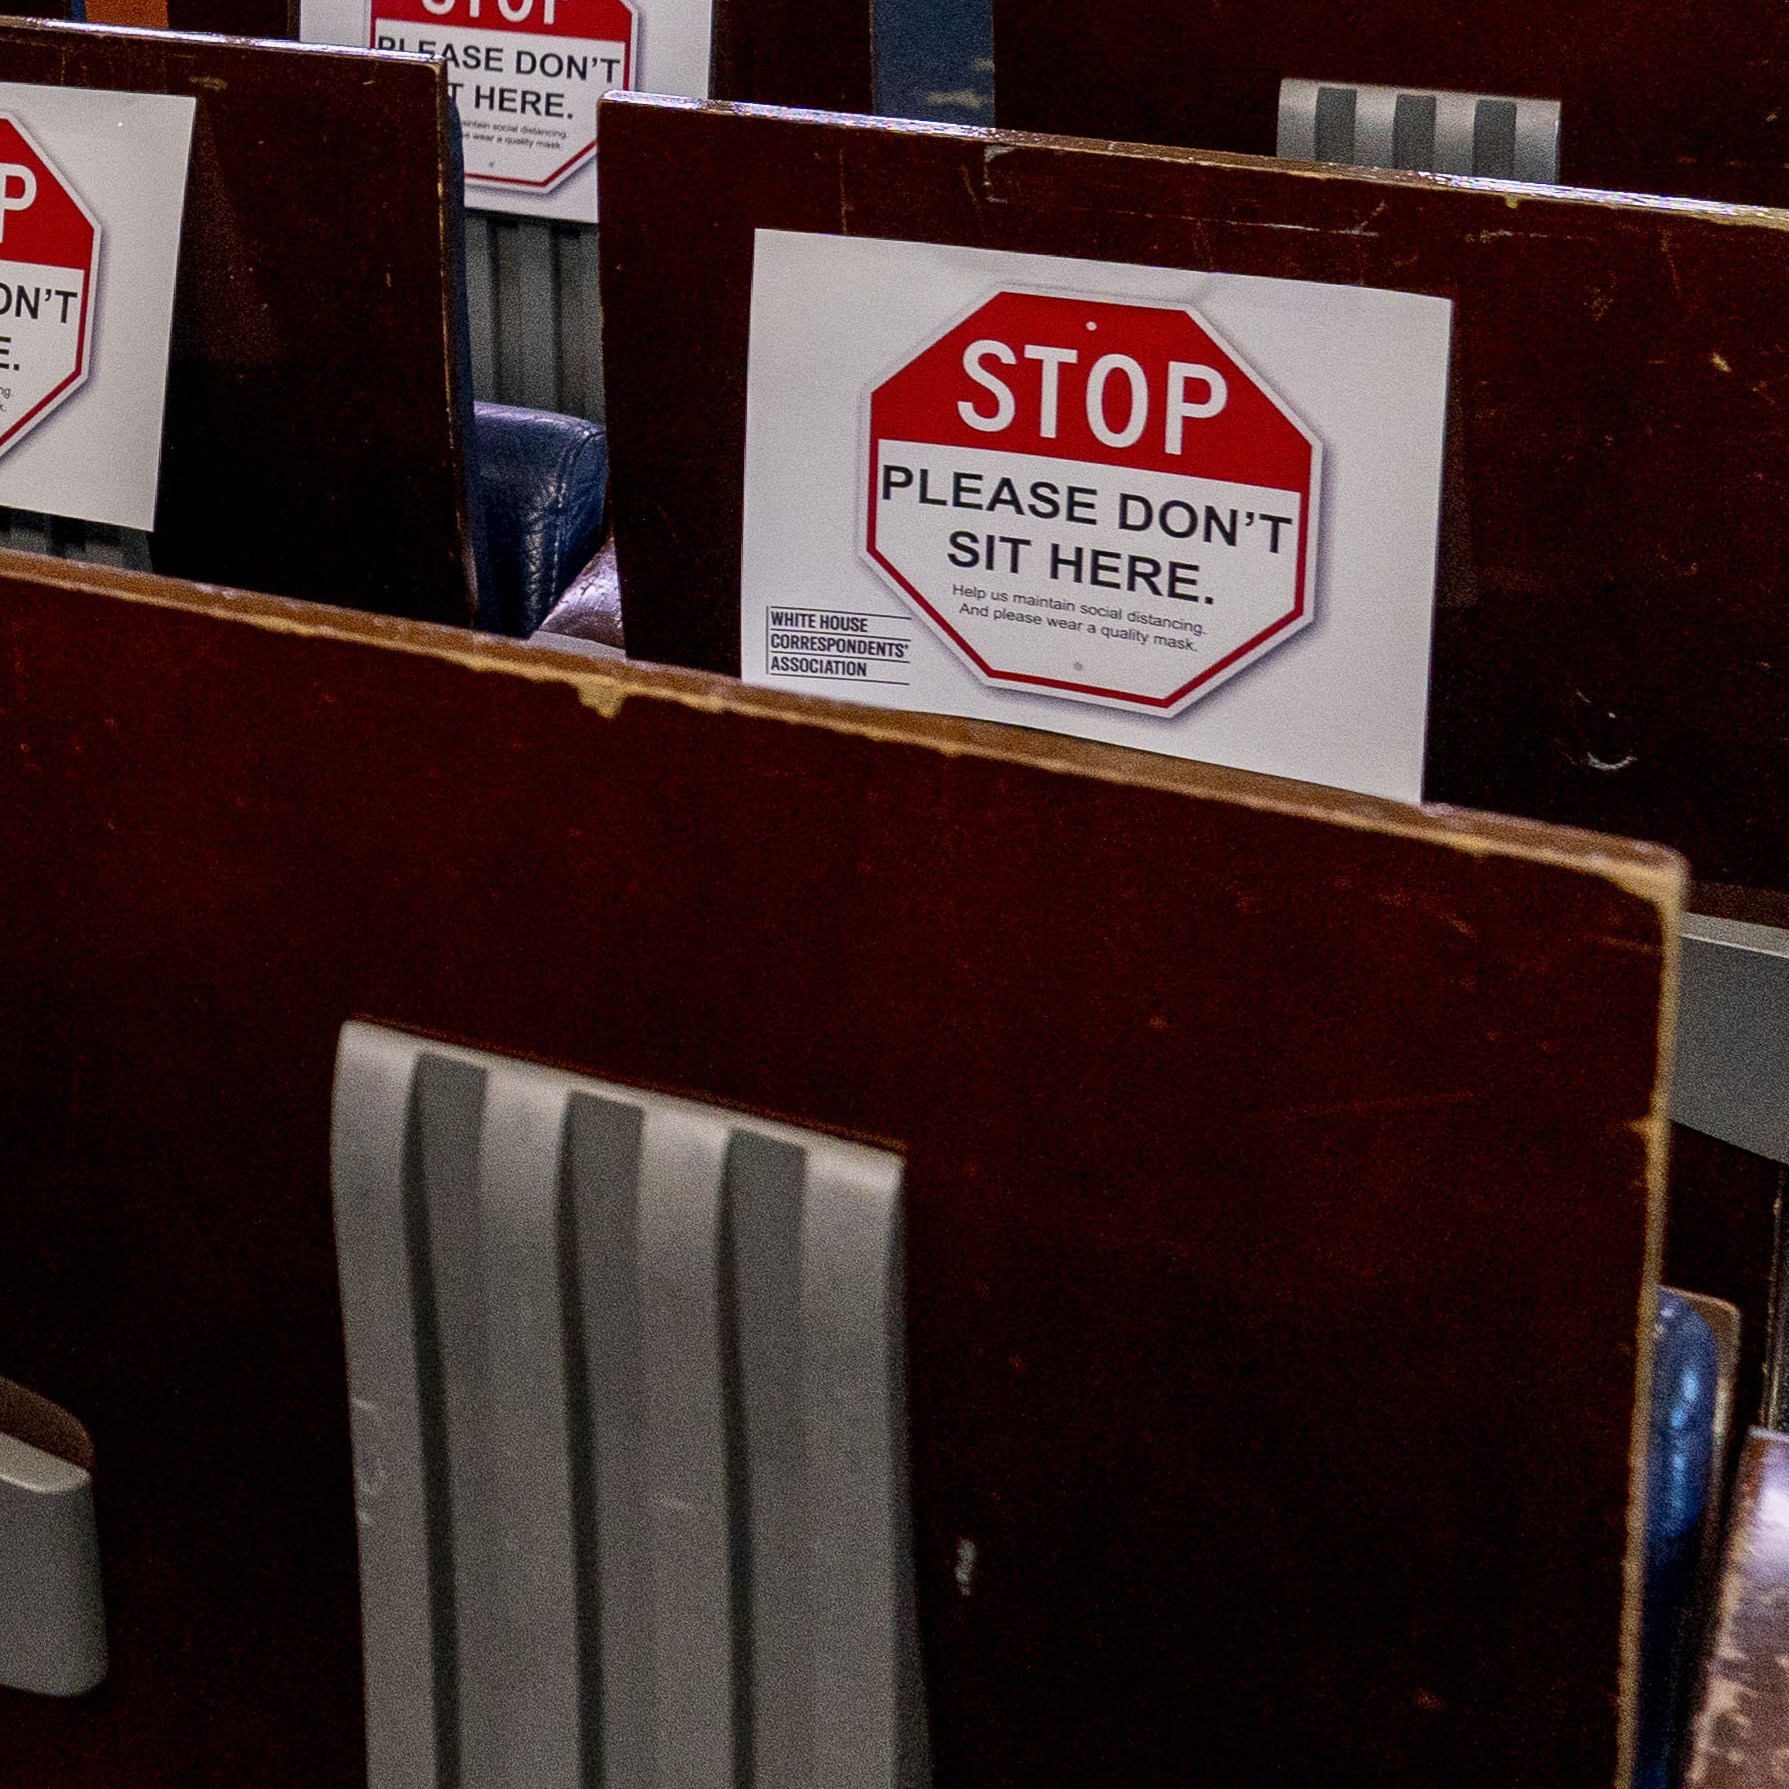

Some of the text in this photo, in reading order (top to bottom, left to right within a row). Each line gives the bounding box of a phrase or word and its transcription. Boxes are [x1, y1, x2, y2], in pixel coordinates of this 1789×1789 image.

[516, 50, 620, 83] DON'T
[474, 85, 573, 119] HERE.
[956, 339, 1228, 456] STOP
[882, 464, 1293, 555] PLEASE DON'T
[947, 530, 1215, 606] SIT HERE.
[771, 611, 868, 632] WHITE HOUSE
[952, 583, 1207, 637] Help us maintain social distancing.
[959, 602, 1198, 652] And please wear a quality mask.
[771, 633, 909, 658] CORRESPONDENTS'
[771, 656, 867, 677] ASSOCIATION
